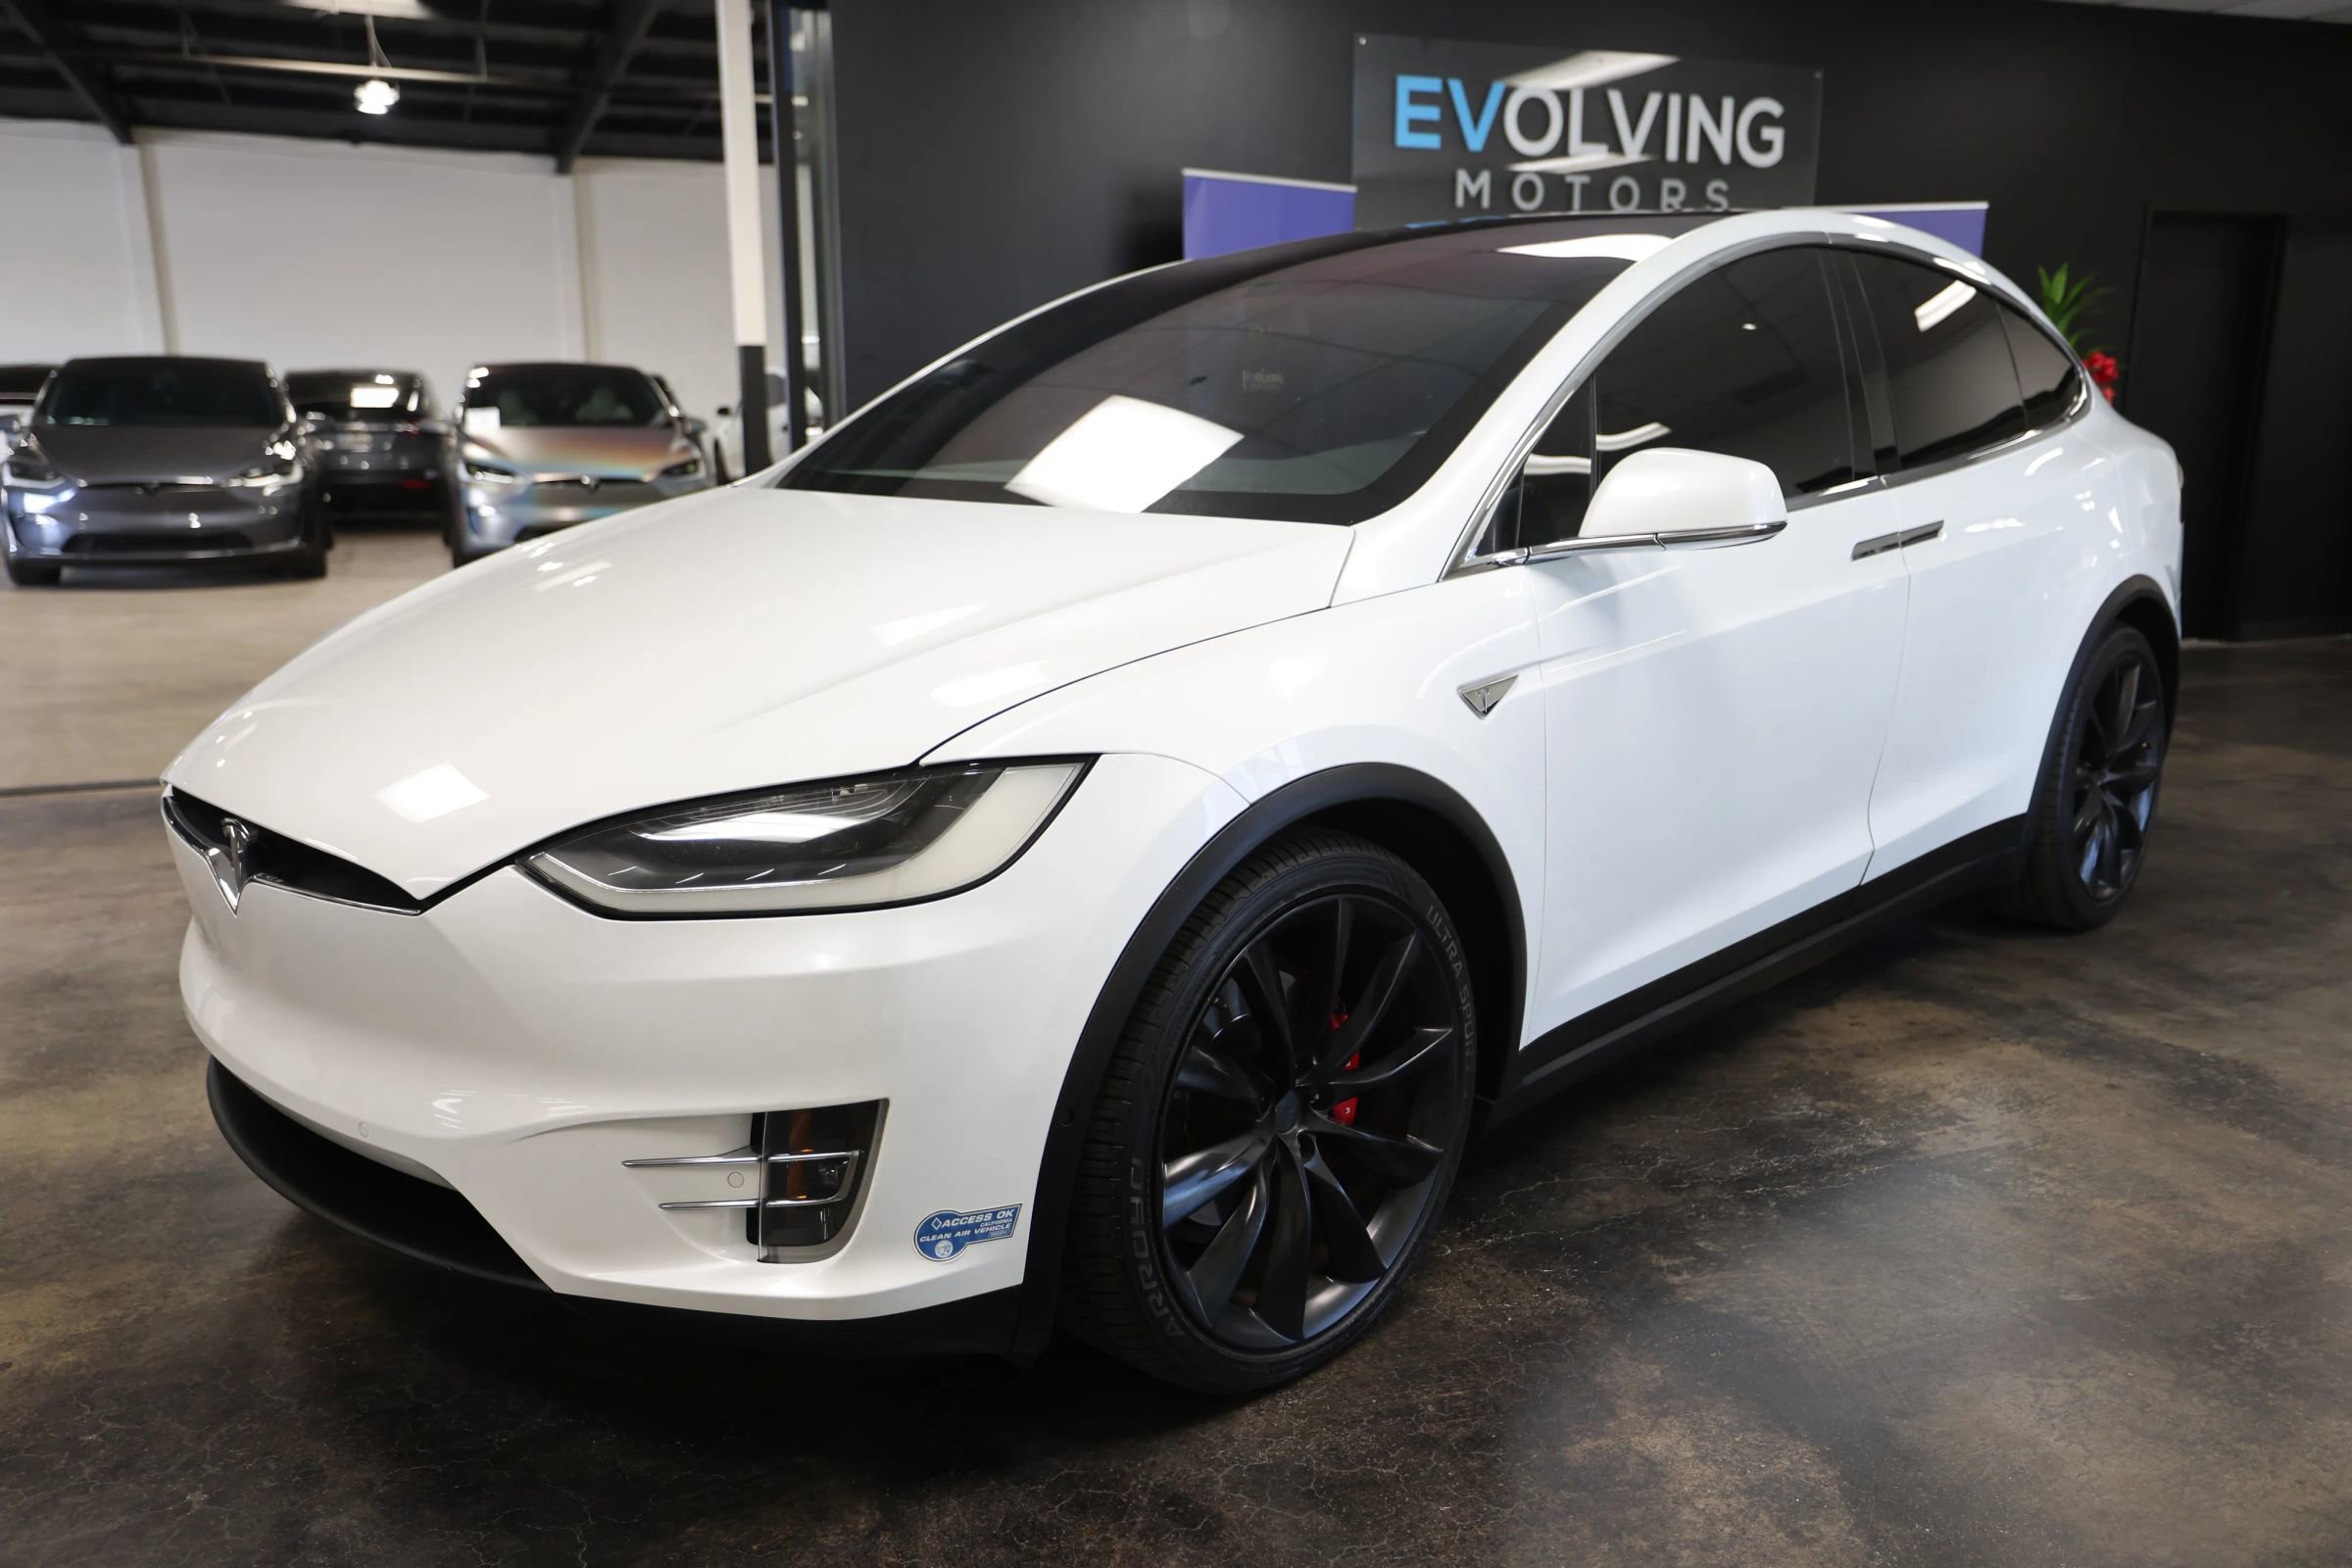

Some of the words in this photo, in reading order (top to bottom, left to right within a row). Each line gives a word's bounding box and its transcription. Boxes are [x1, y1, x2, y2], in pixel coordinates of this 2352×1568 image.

[1395, 74, 1785, 168] EVOLVING
[1455, 168, 1730, 212] MOTORS
[1426, 905, 1462, 978] ULTRA
[919, 1233, 952, 1243] CLEAN
[974, 1223, 1011, 1234] VEHICLE
[941, 1213, 993, 1228] ACCESS
[996, 1208, 1015, 1219] OK
